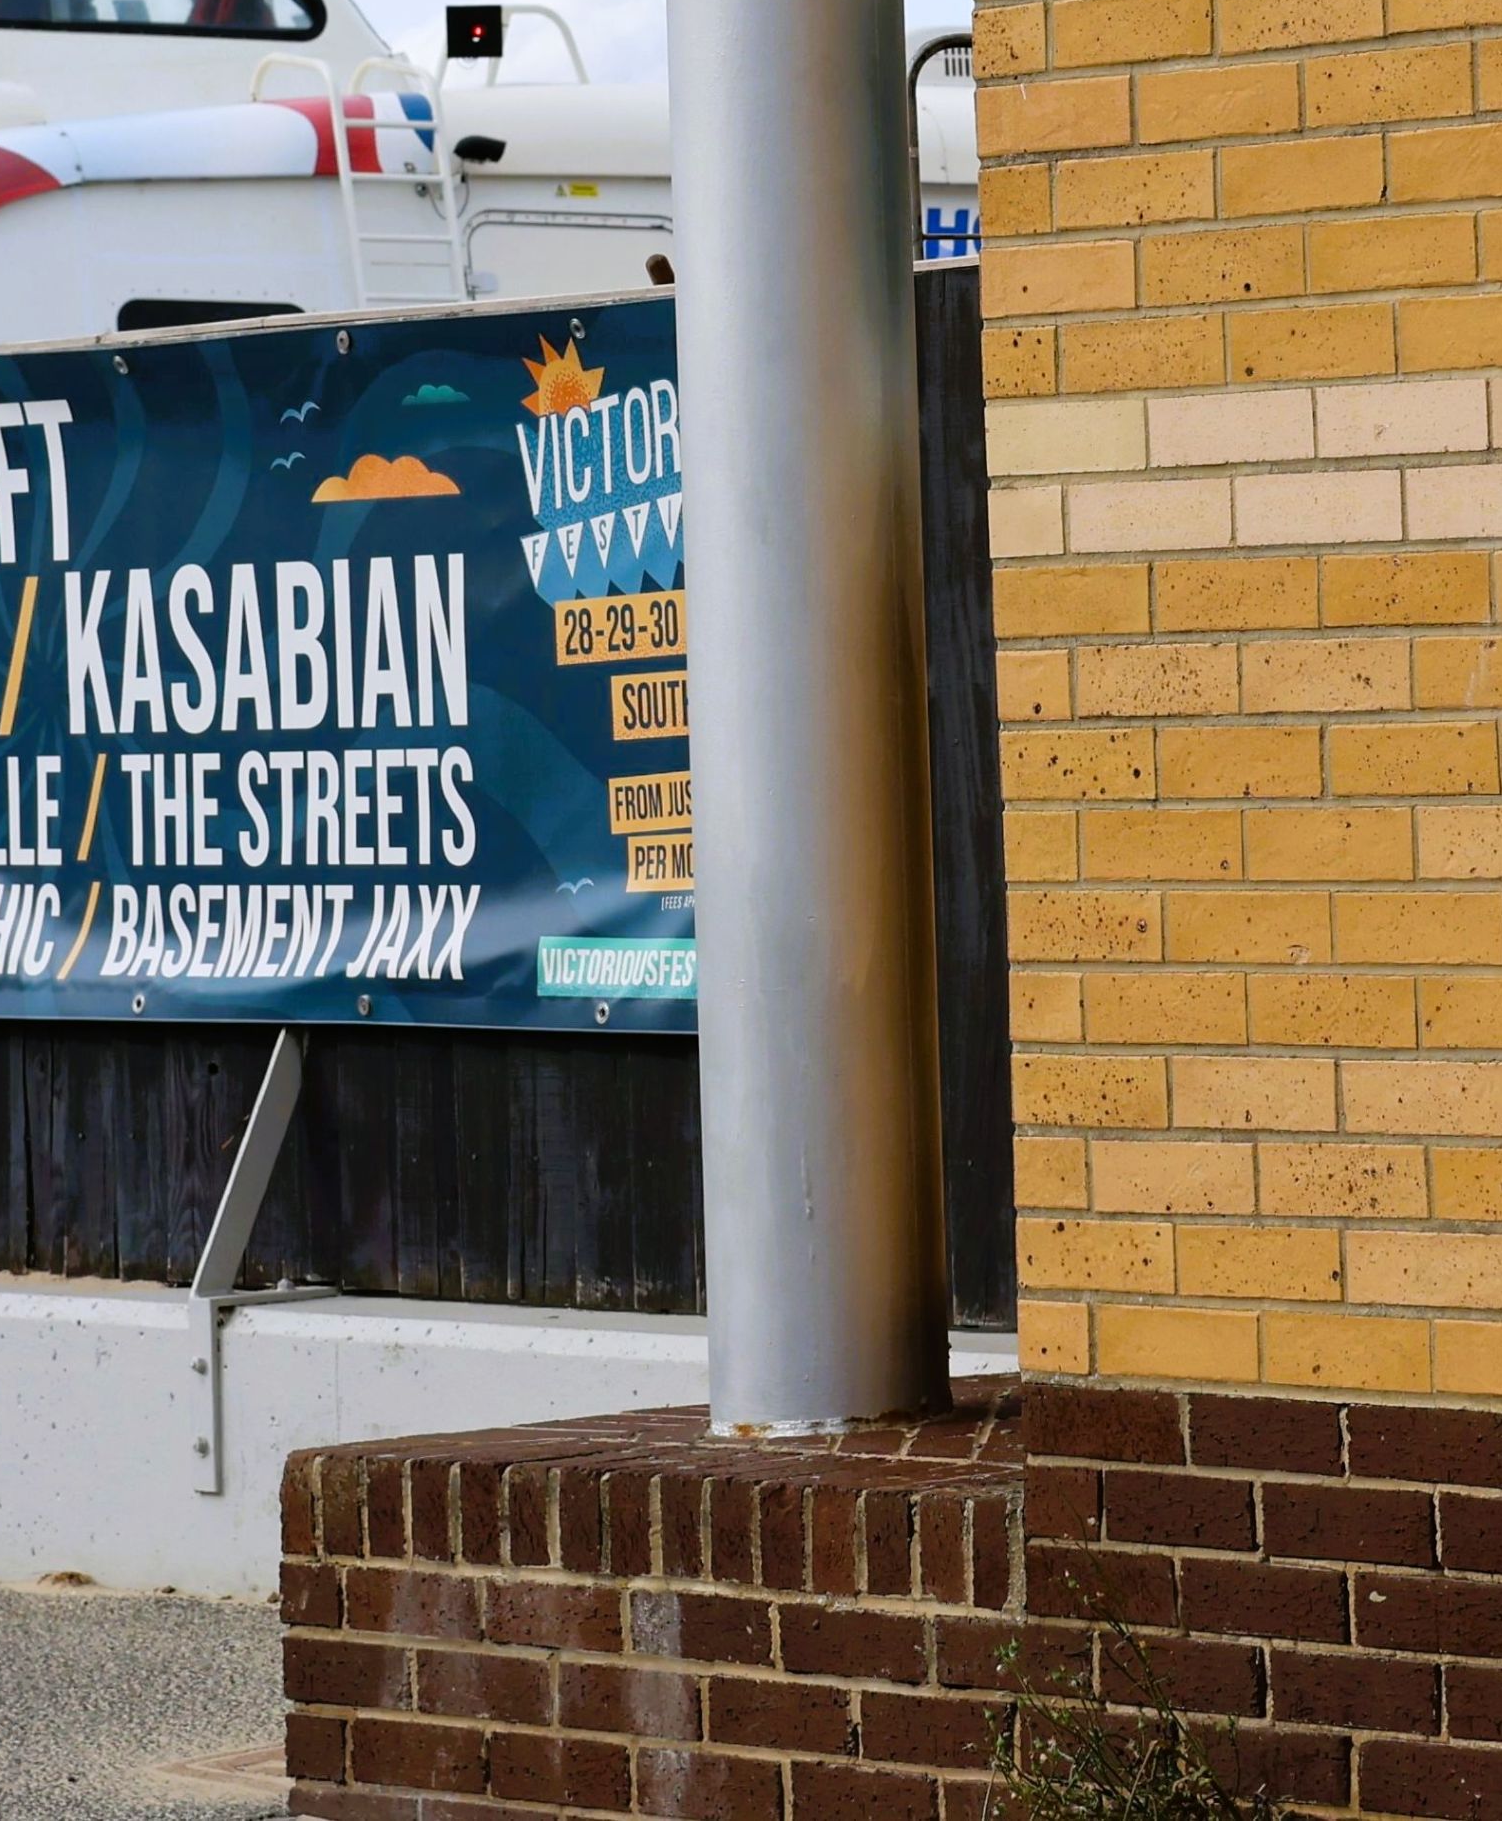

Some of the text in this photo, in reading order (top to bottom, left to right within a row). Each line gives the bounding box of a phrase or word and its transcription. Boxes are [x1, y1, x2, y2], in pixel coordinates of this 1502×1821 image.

[515, 378, 682, 517] VICTOR
[65, 553, 468, 735] KASABIAN
[563, 598, 679, 657] 28-29-30
[121, 752, 223, 867] THE
[238, 746, 477, 867] STREETS
[615, 782, 663, 822] FROM
[634, 844, 667, 881] PER
[99, 883, 355, 978] BASEMENT
[345, 883, 482, 981] JAXX
